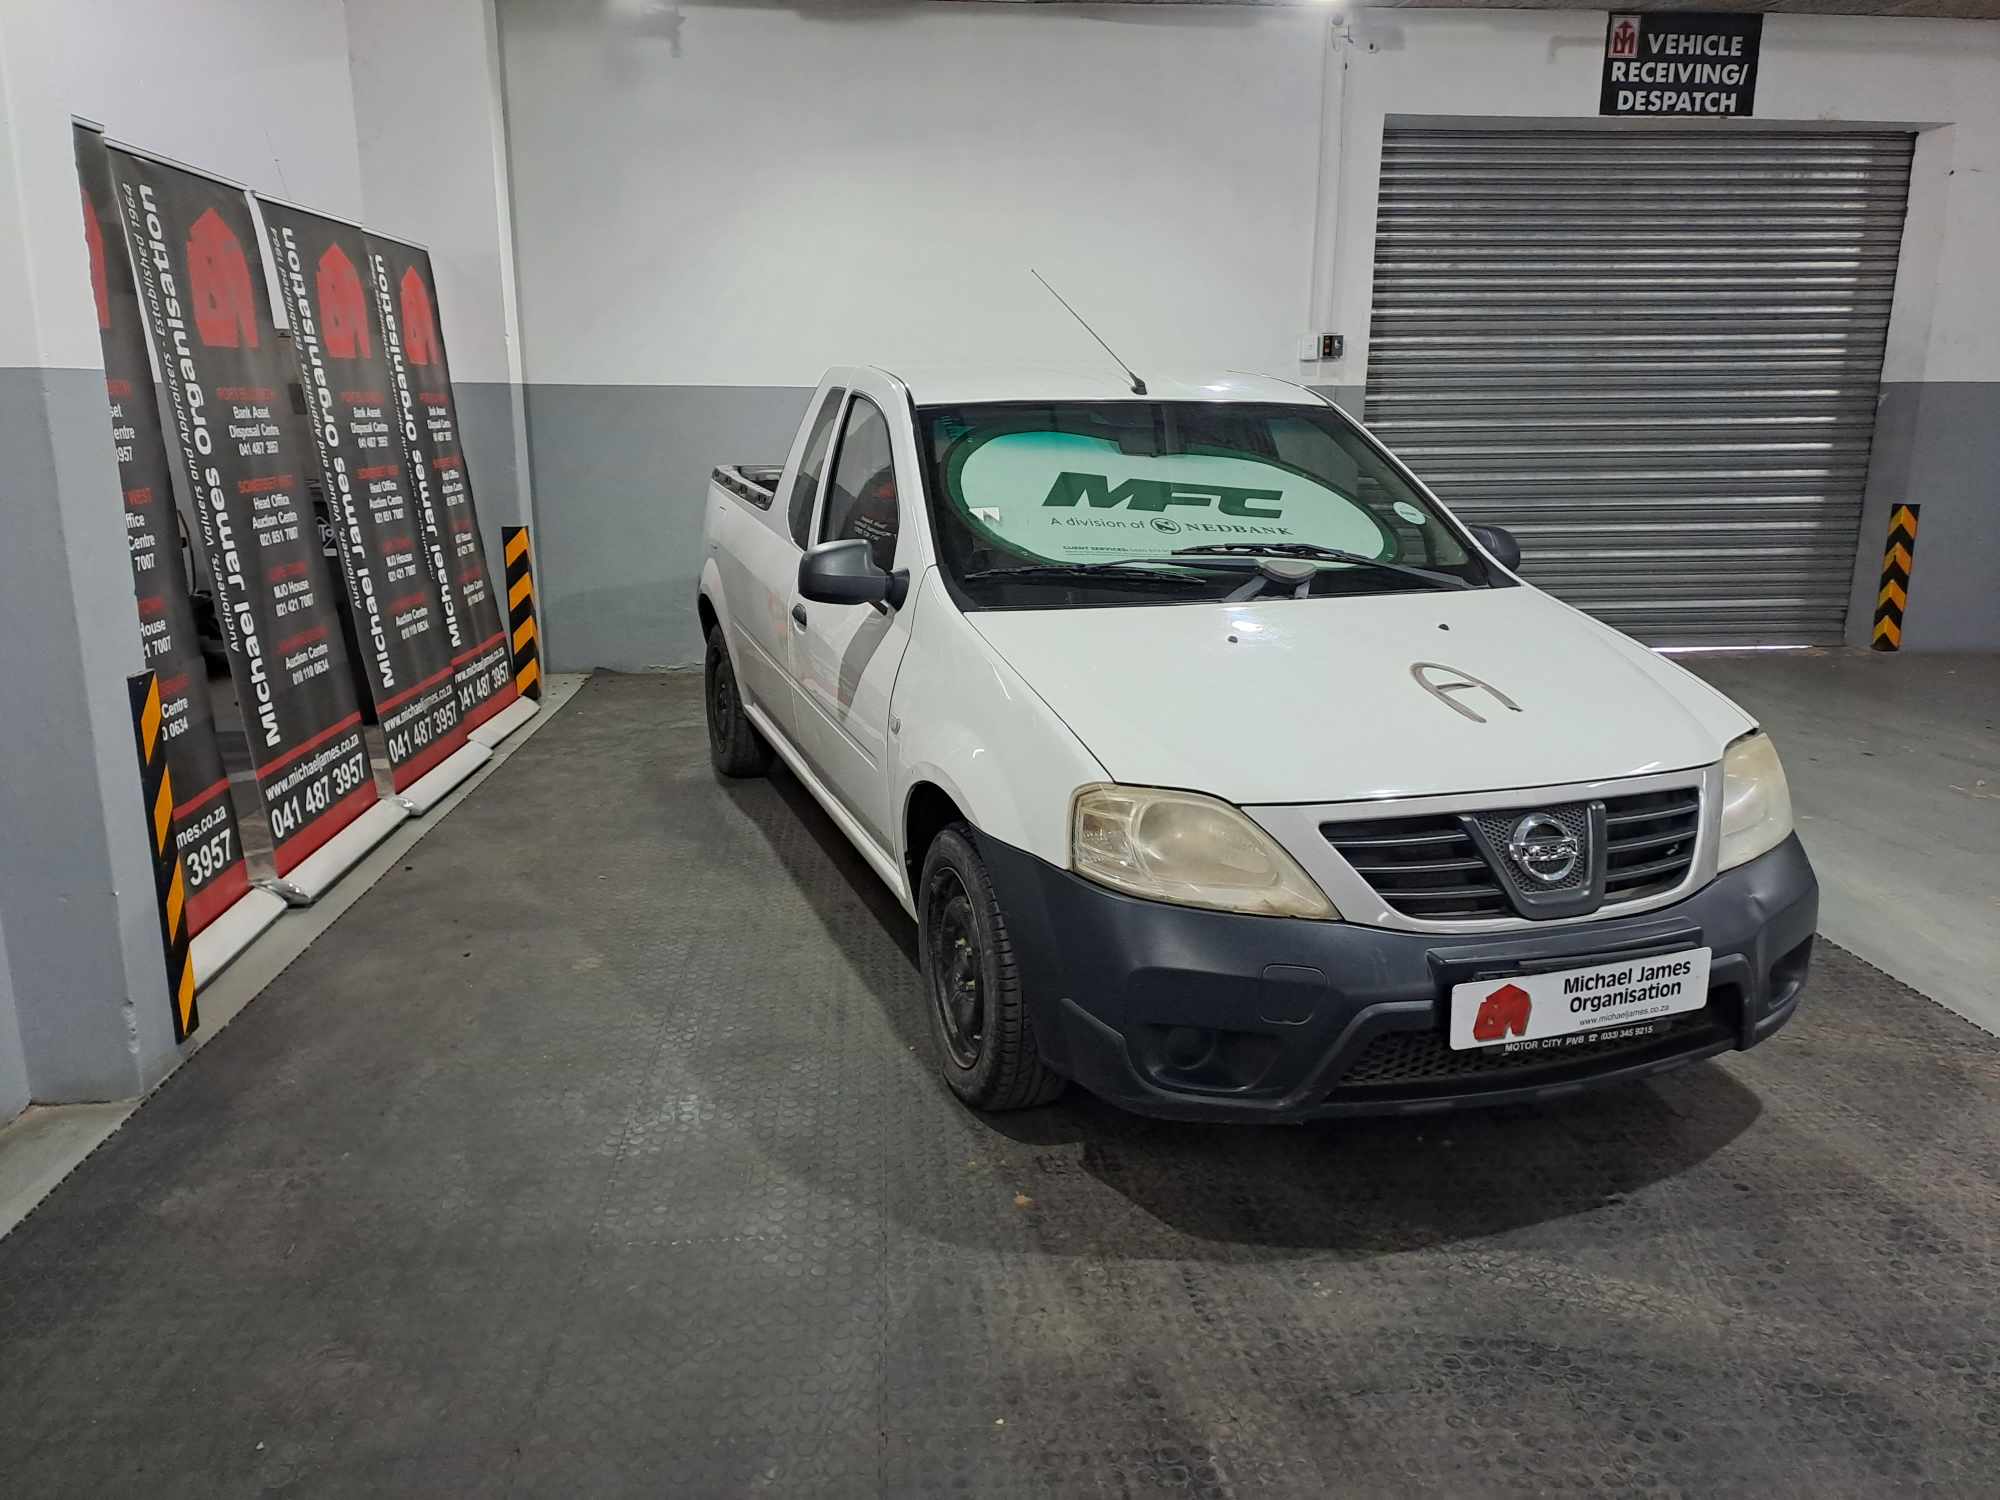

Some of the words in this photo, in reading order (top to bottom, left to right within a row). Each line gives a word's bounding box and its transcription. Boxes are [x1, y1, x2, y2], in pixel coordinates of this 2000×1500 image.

[1647, 33, 1744, 57] VEHICLE
[1611, 61, 1749, 86] RECEIVING/
[1616, 90, 1737, 113] DESPATCH
[122, 182, 141, 229] 1964
[133, 232, 166, 337] Established
[139, 184, 212, 456] Organisation
[281, 227, 340, 447] Organisation
[375, 254, 417, 441] Organisation
[163, 352, 191, 444] Appraisers
[113, 425, 135, 440] entre
[117, 446, 133, 463] 957
[183, 447, 199, 481] and
[194, 485, 215, 546] Valuers
[333, 457, 366, 559] James
[412, 450, 438, 537] James
[1041, 471, 1284, 519] MFC
[125, 512, 145, 528] ffice
[205, 467, 246, 591] James
[1050, 517, 1062, 526] A
[1066, 517, 1127, 529] division
[1130, 520, 1145, 529] of
[1184, 522, 1295, 536] NEDBANK
[134, 553, 155, 572] 7007
[430, 544, 462, 648] Michael
[151, 636, 172, 656] 7007
[357, 568, 395, 688] Michael
[234, 601, 281, 748] Michael
[476, 673, 491, 698] 487
[492, 661, 509, 689] 3957
[161, 697, 188, 718] Centre
[169, 716, 189, 738] 0634
[389, 730, 412, 763] 041
[414, 716, 432, 746] 487
[433, 701, 457, 734] 3957
[265, 733, 360, 802] www.michaeljames.co.za
[271, 795, 303, 838] 041
[305, 775, 331, 814] 487
[332, 752, 365, 795] 3957
[176, 806, 227, 850] mes.co.za
[187, 828, 231, 886] 3957
[1563, 968, 1633, 995] Michael
[1636, 960, 1691, 983] James
[1570, 981, 1682, 1013] Organisation
[1580, 1004, 1670, 1026] www.michaeljames.co.za
[1504, 1040, 1538, 1052] MOTOR
[1542, 1038, 1563, 1048] CITY
